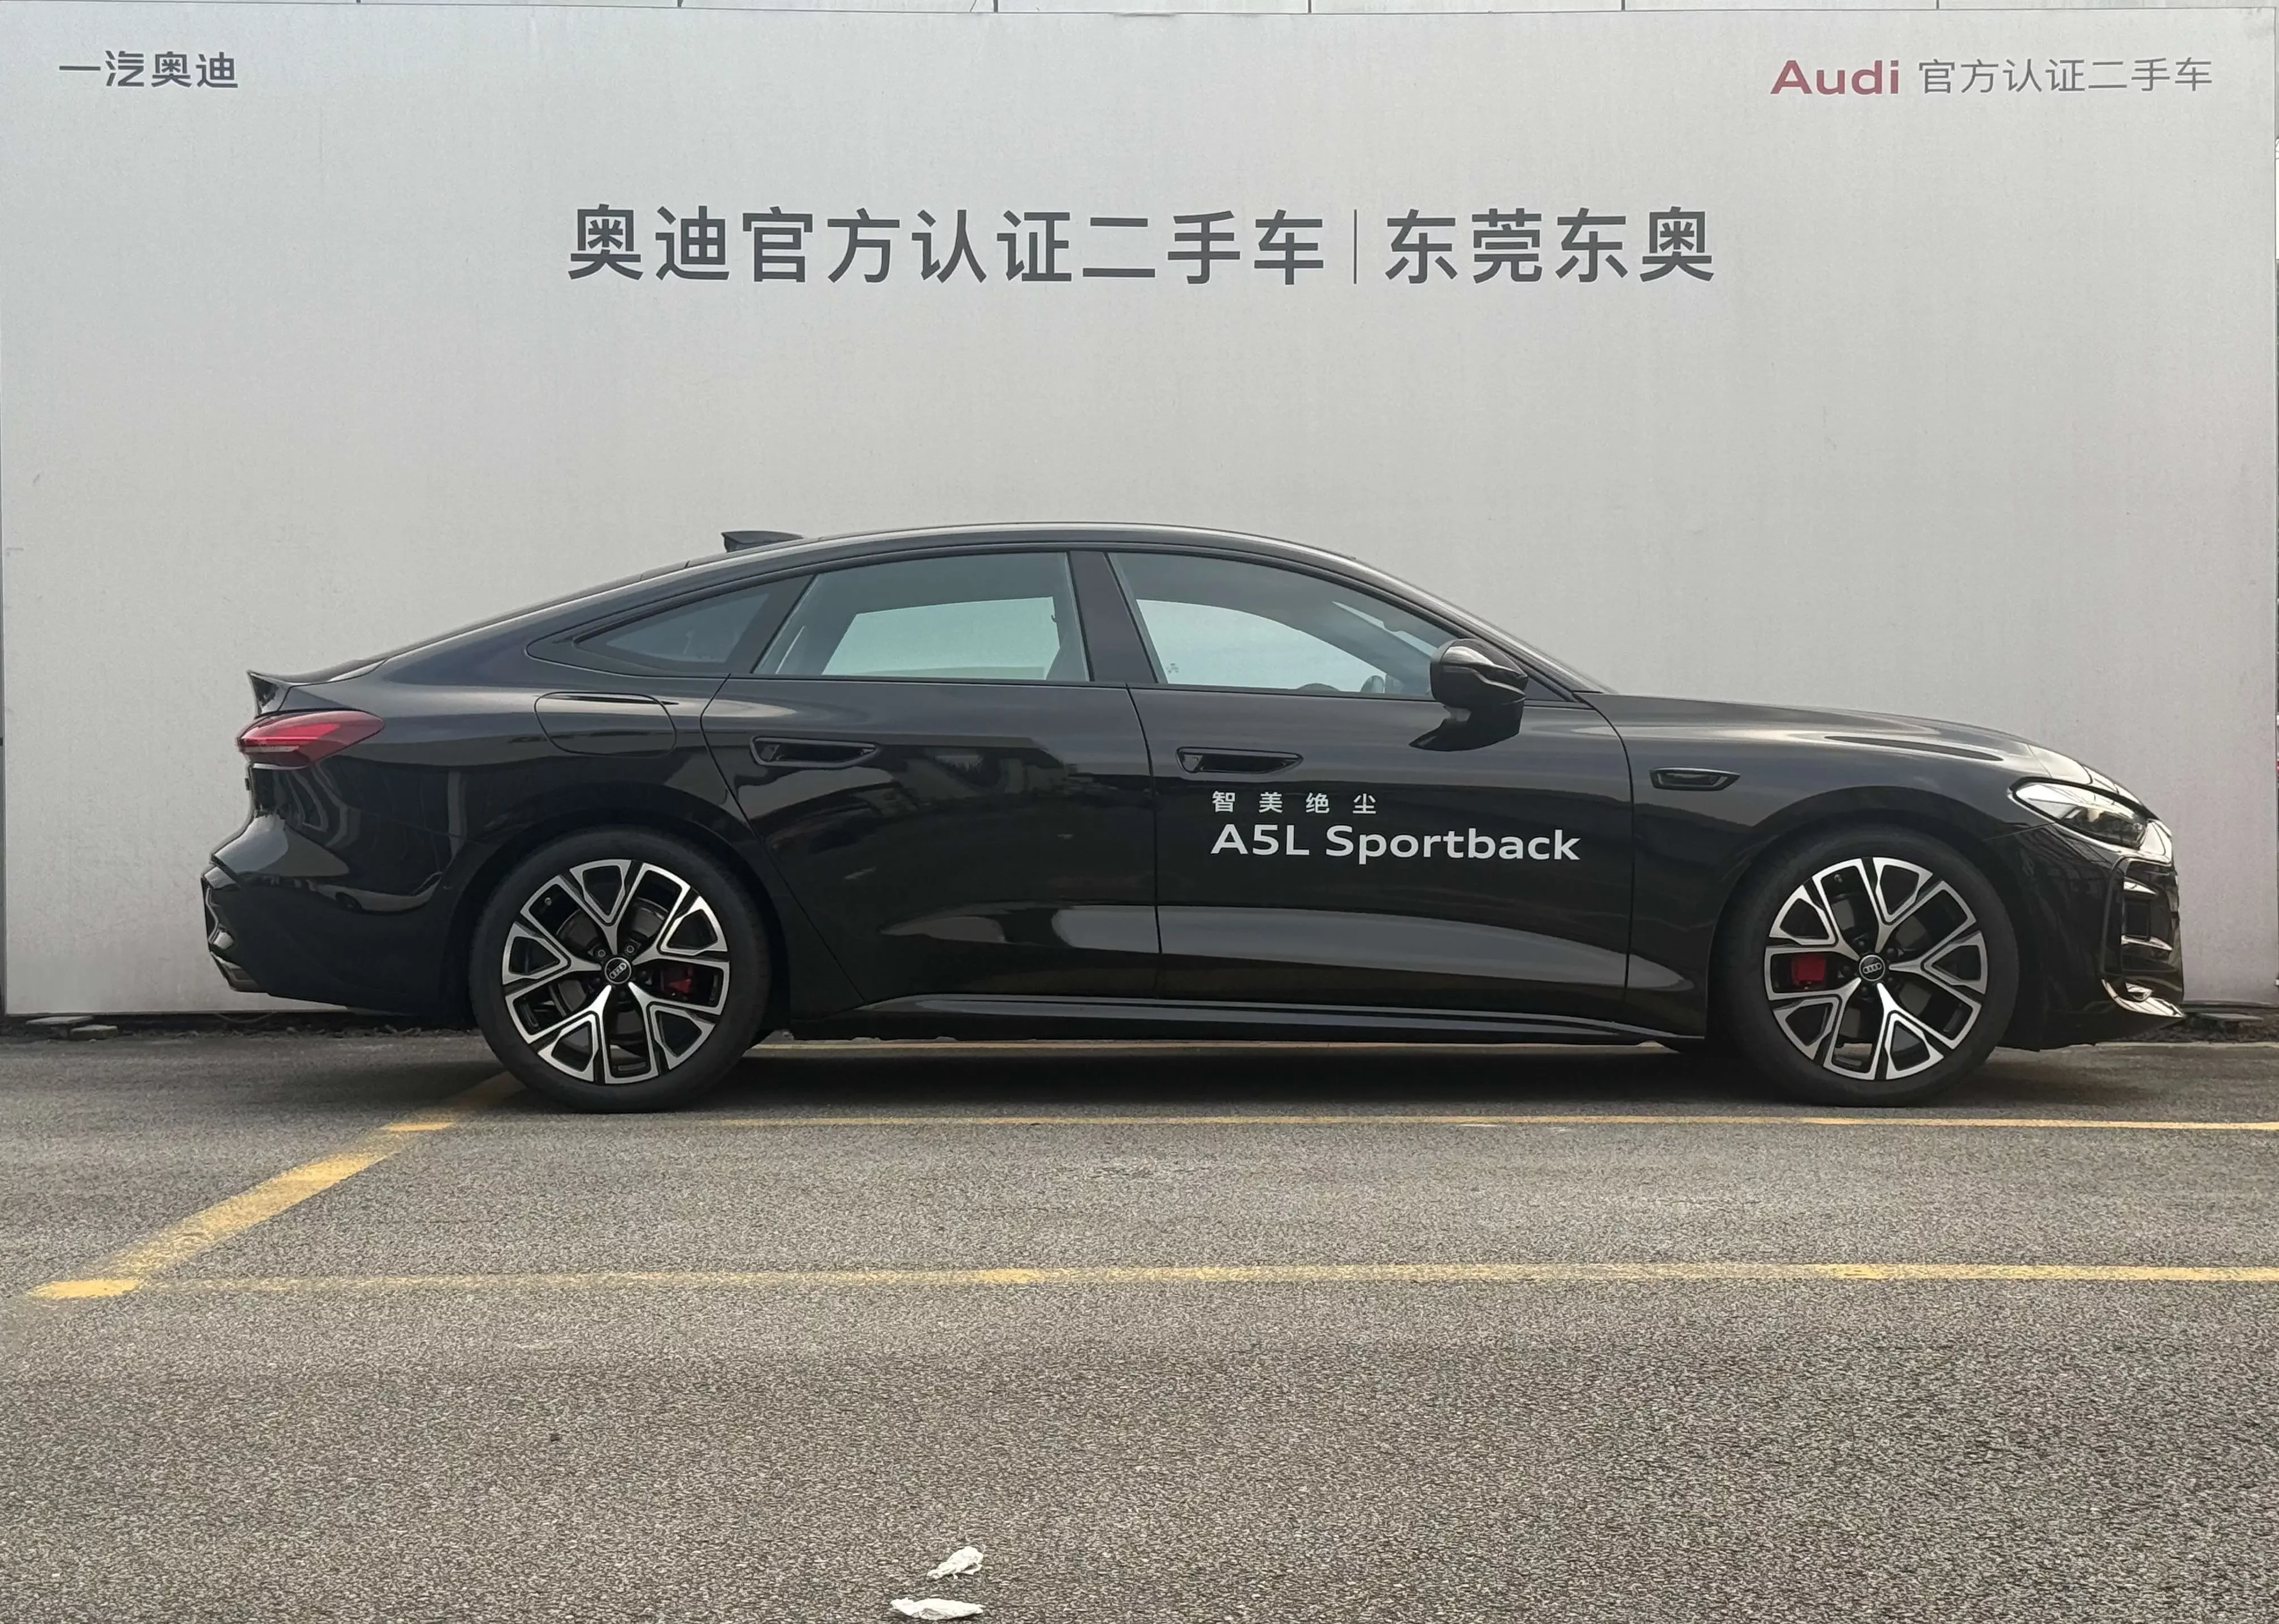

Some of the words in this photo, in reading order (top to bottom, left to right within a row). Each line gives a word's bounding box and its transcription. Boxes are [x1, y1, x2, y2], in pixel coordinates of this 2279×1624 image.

[59, 51, 238, 88] 一汽奥迪
[1770, 60, 1899, 95] Audi
[1919, 57, 2212, 94] 官方认证二手车
[567, 203, 1324, 285] 奥迪官方认证二手车
[1385, 206, 1714, 284] 东莞东奥
[1212, 790, 1377, 814] 智美绝尘
[1211, 824, 1310, 856] A5L
[1326, 825, 1580, 865] Sportback
